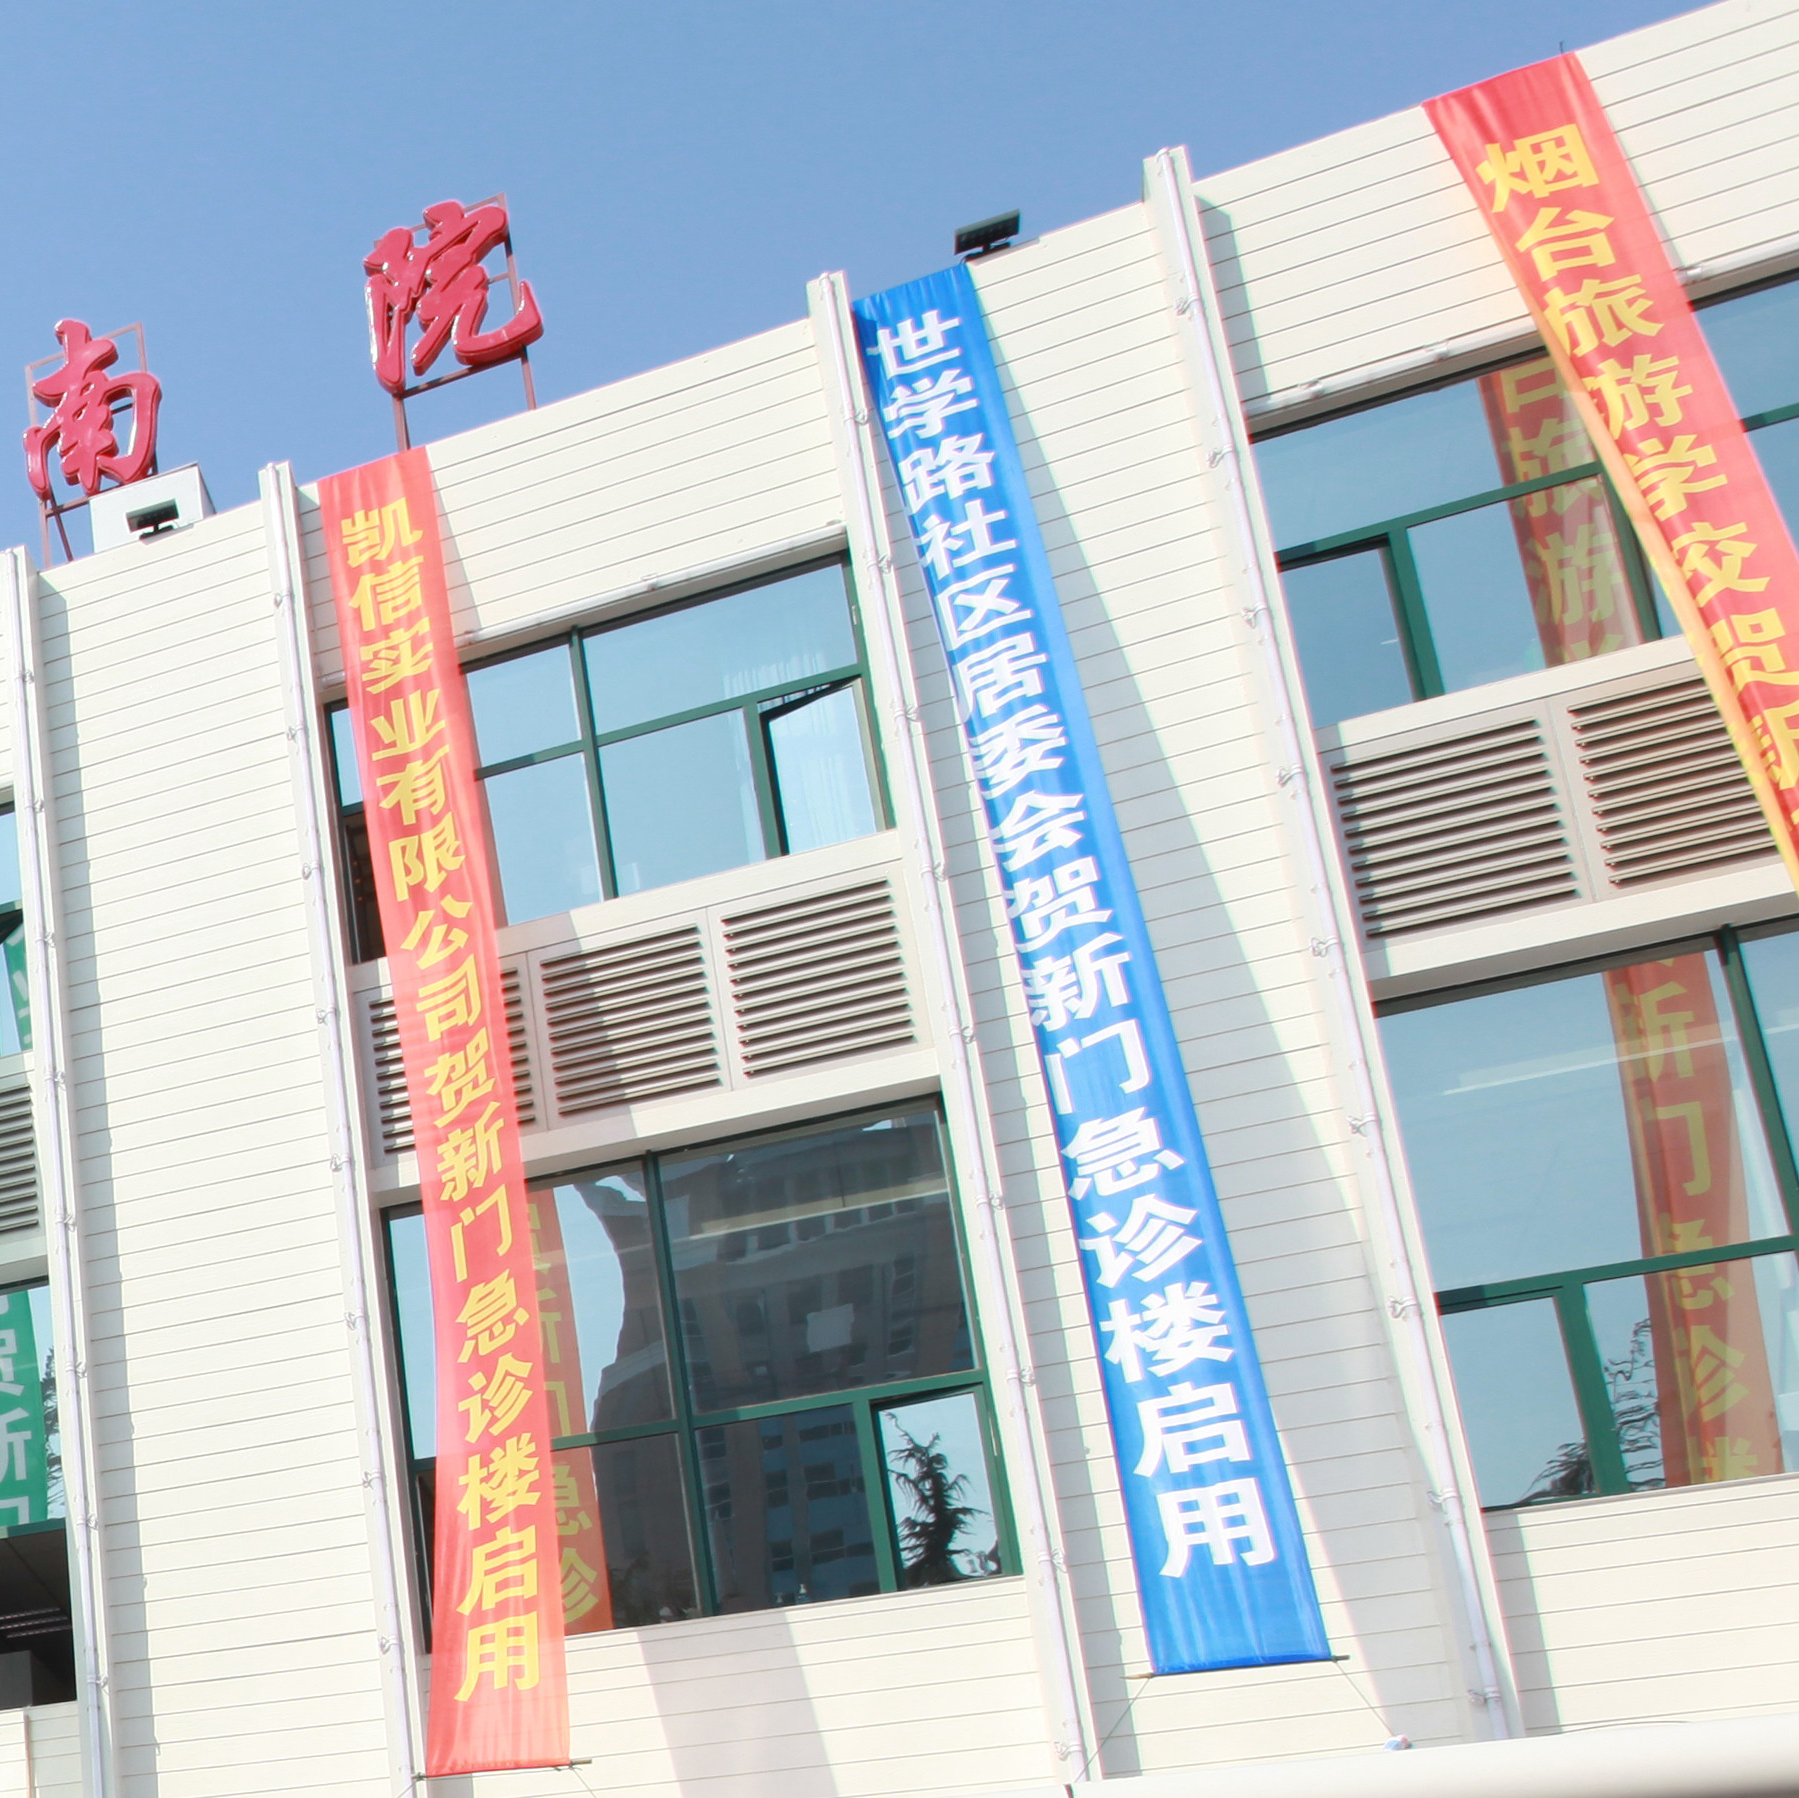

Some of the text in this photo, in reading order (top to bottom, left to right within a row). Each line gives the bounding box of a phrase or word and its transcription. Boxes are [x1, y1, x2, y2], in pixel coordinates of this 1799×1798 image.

[341, 496, 542, 1701] 凯信实业有限公司贺新门急诊楼启用
[870, 309, 1276, 1577] 世学路社区居委会贺新门急诊楼启用
